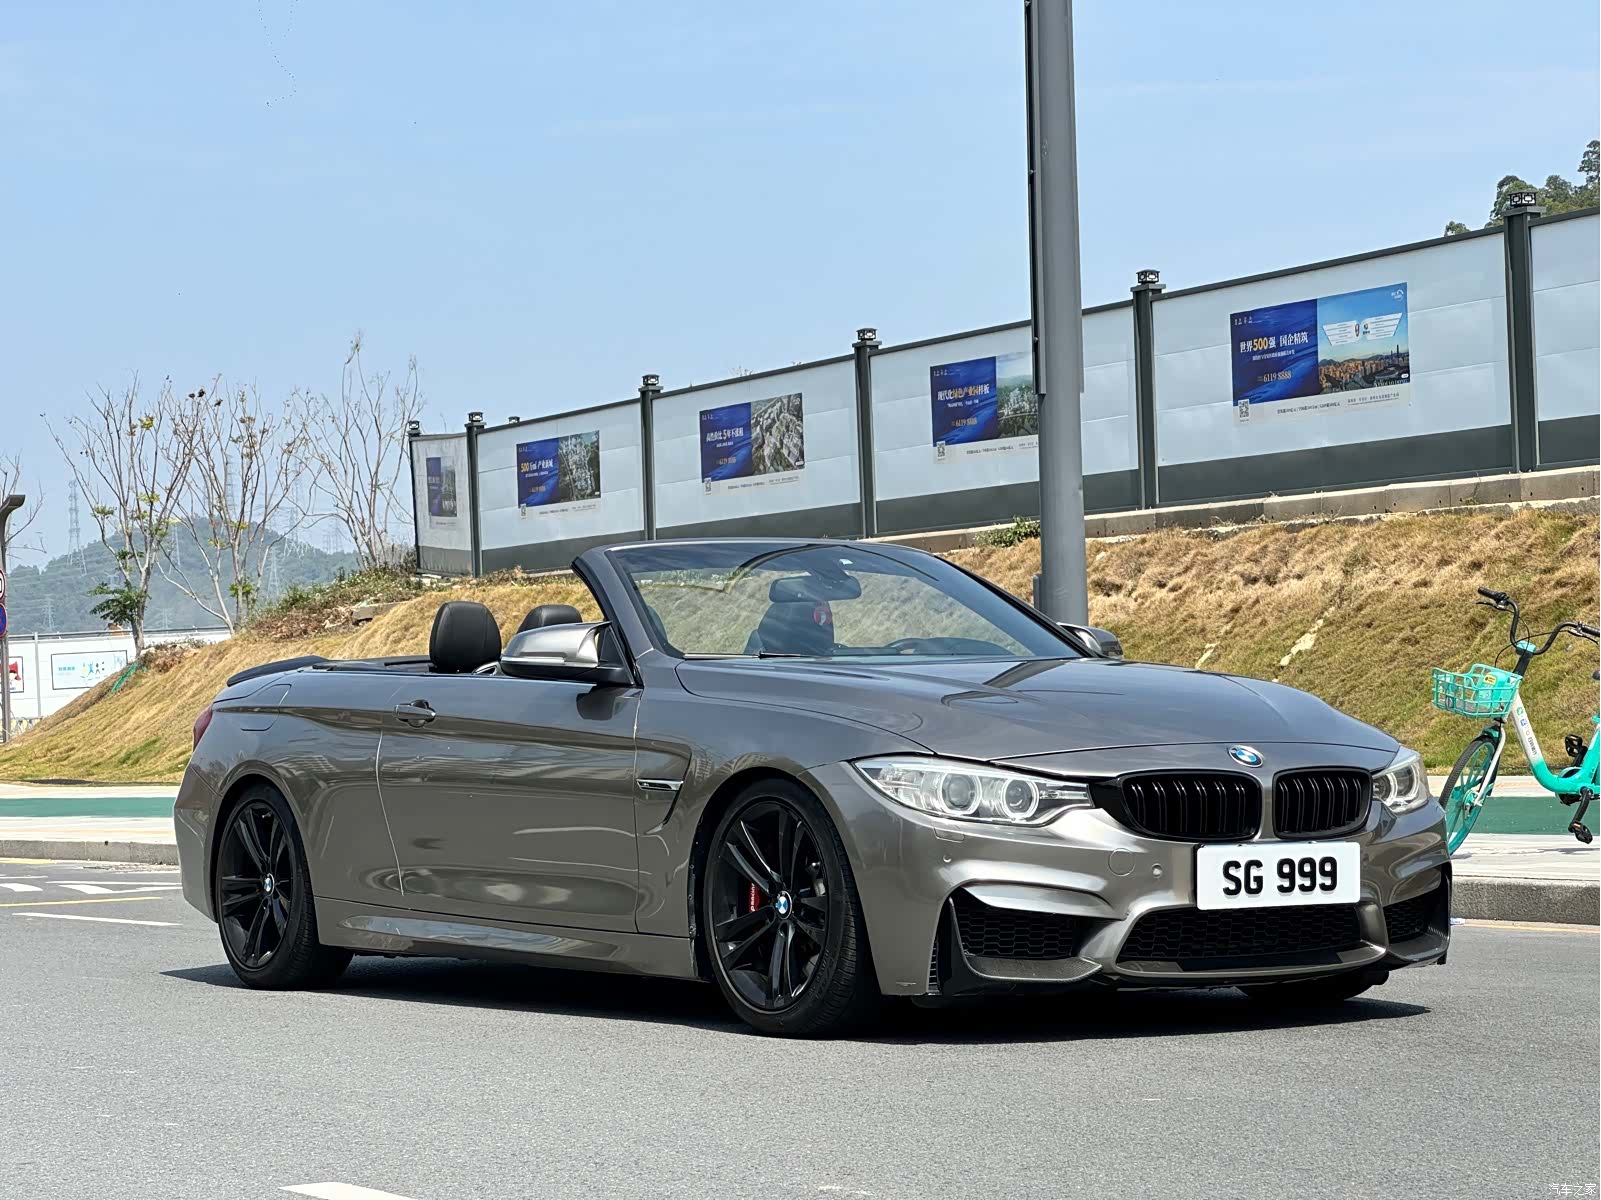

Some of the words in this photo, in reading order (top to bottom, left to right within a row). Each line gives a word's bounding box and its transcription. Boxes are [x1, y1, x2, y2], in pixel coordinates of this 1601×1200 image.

[1239, 336, 1277, 353] 世界500强
[1279, 331, 1309, 348] 国企精筑
[1263, 373, 1277, 383] 6119
[1277, 370, 1292, 381] 8888
[1222, 859, 1264, 896] SG
[1276, 855, 1338, 893] 999
